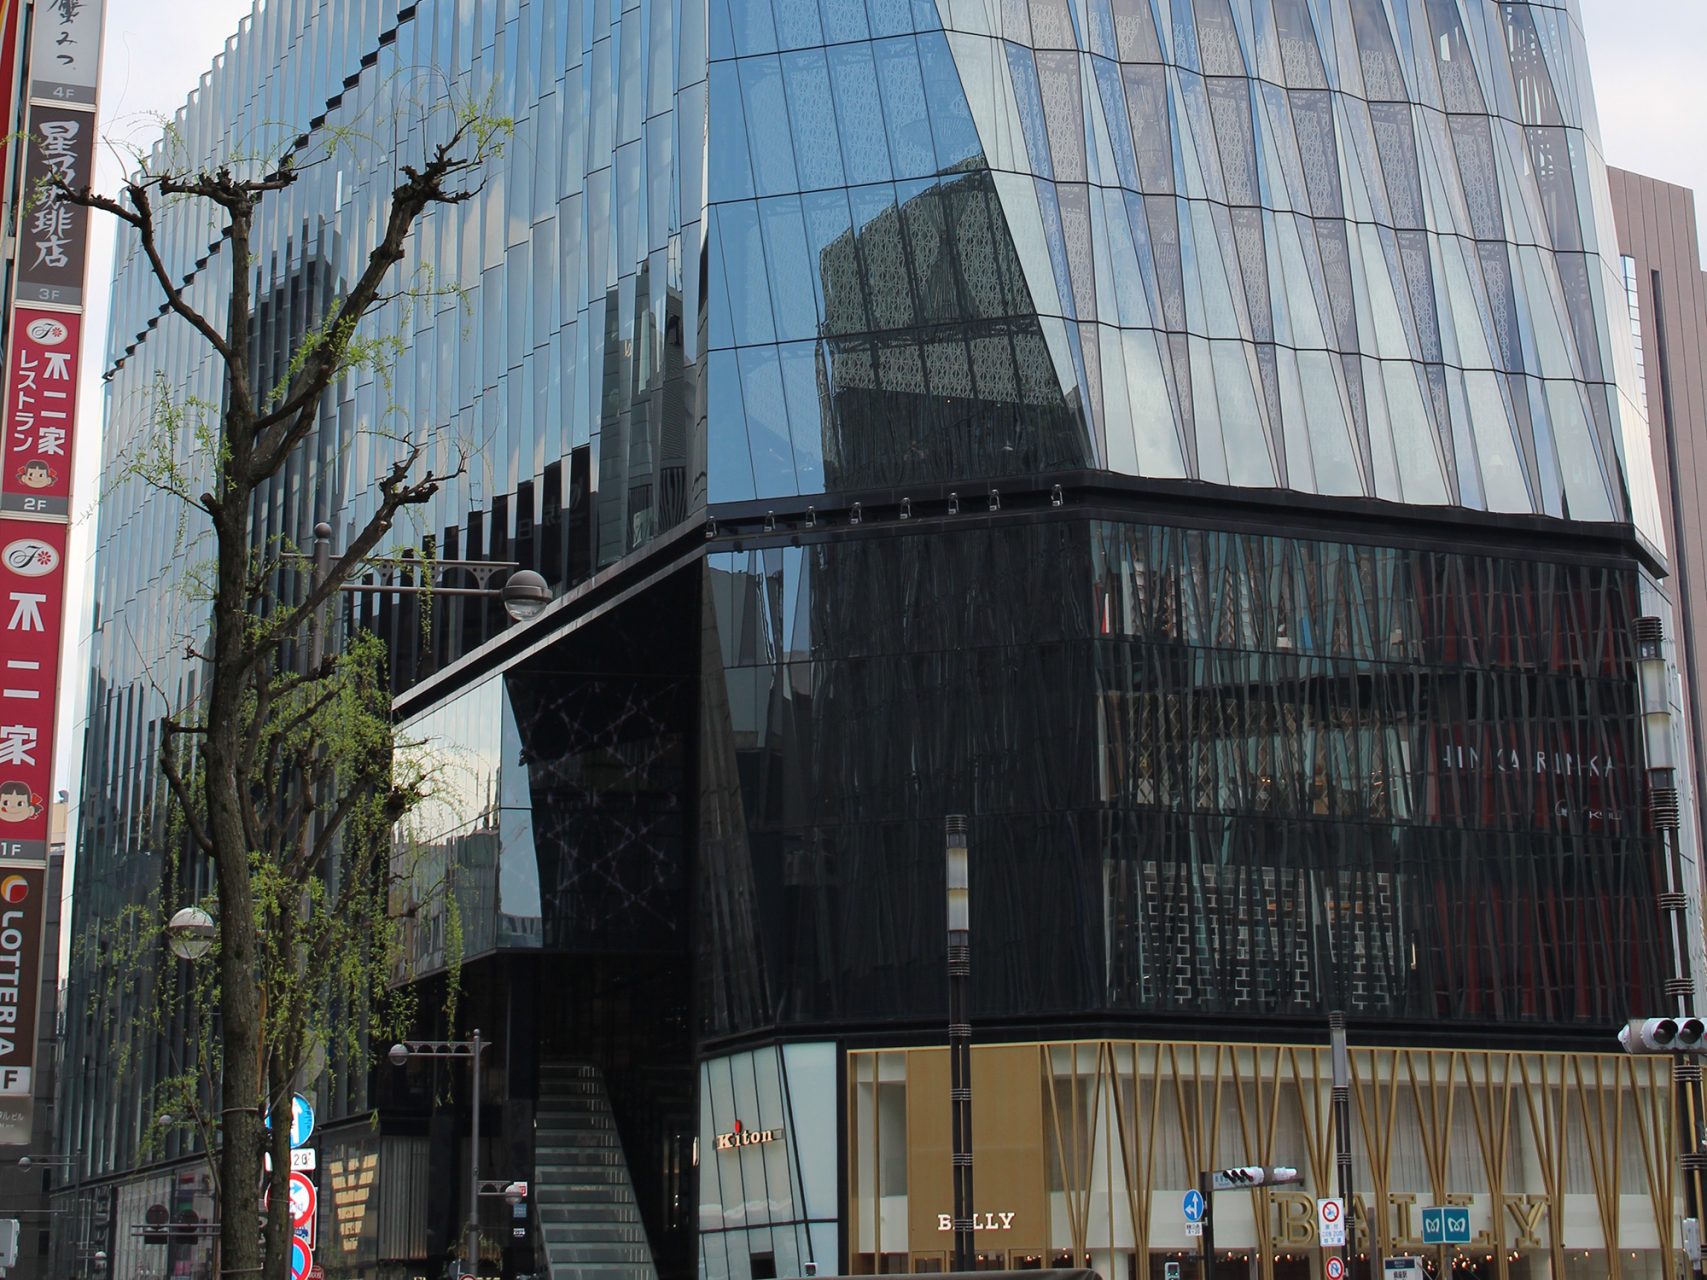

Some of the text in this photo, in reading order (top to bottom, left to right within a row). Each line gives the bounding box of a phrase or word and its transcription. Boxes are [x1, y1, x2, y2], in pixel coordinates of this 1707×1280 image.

[53, 86, 75, 99] 4F
[39, 288, 60, 300] 3F
[13, 349, 38, 452] レストラン
[38, 351, 71, 456] 不二家
[24, 497, 47, 510] 2F
[0, 591, 47, 766] 不二家
[1, 842, 21, 857] 1F
[0, 911, 23, 1056] LOTTERIA
[716, 1120, 773, 1150] Kiton
[937, 1212, 1015, 1231] BLLY
